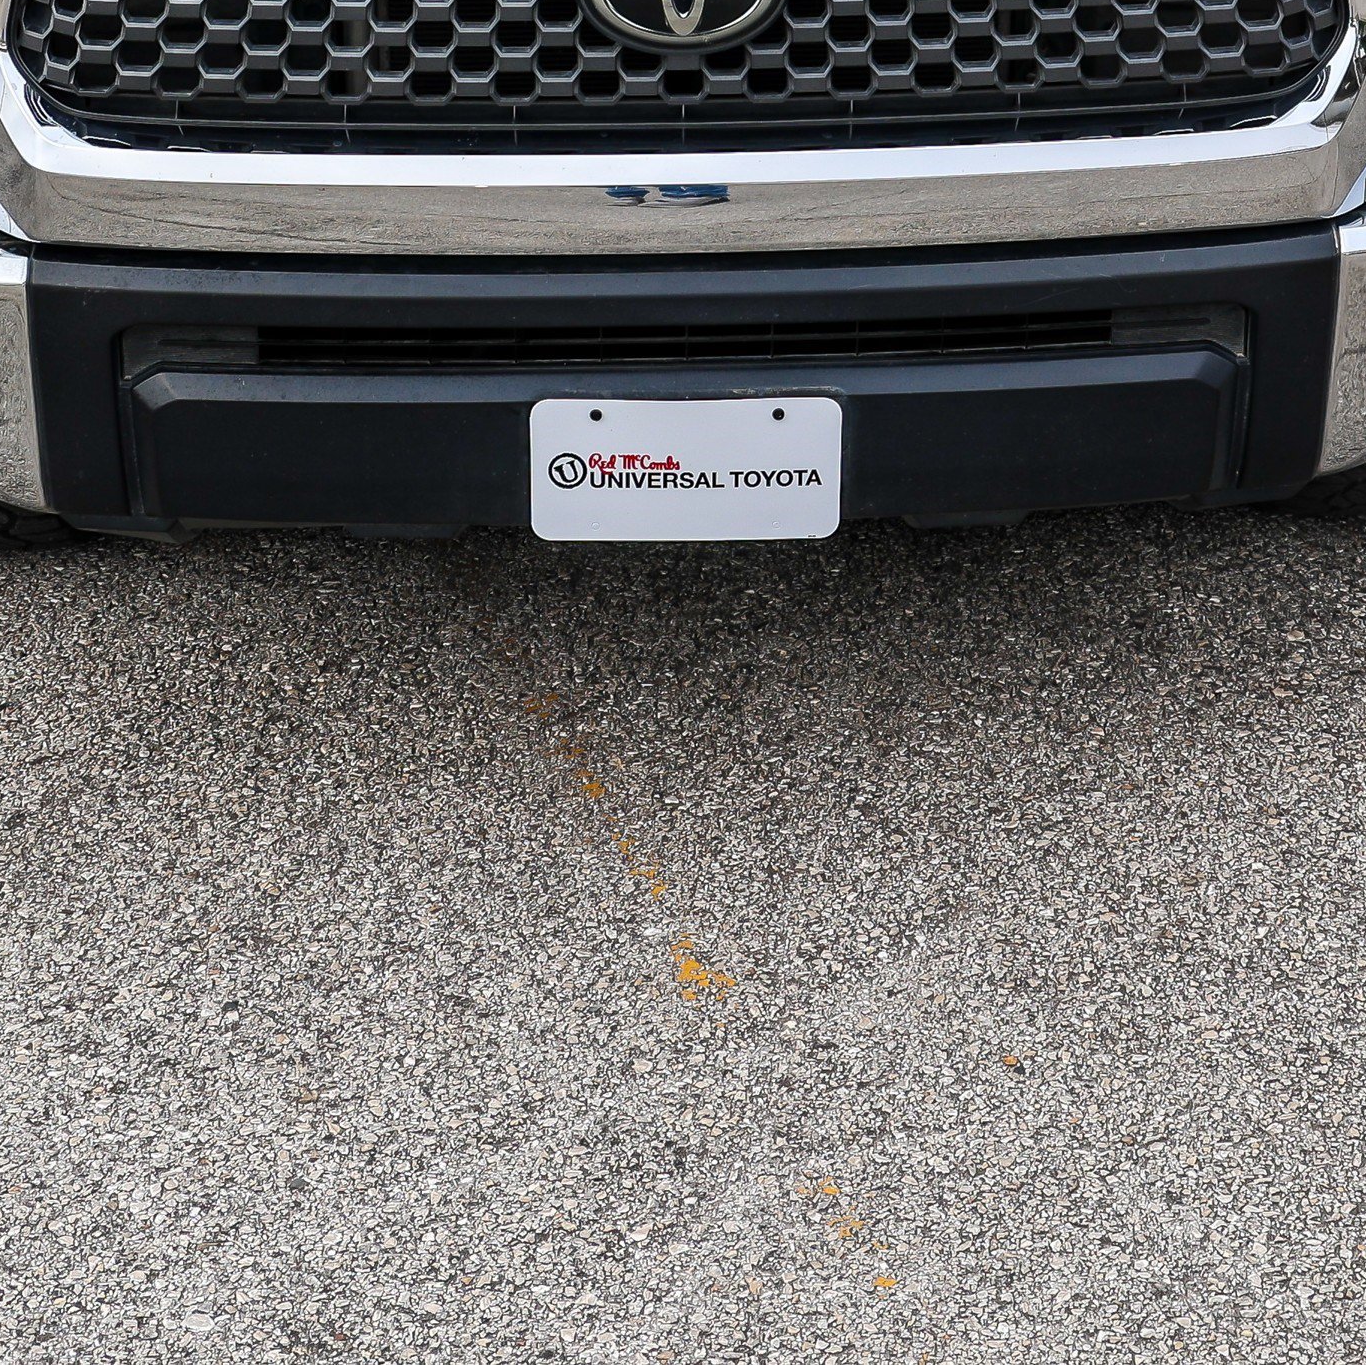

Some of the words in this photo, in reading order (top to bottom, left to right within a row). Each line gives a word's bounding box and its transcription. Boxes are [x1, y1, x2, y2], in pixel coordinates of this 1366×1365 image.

[588, 453, 617, 475] Red
[618, 454, 681, 471] McCombs
[589, 471, 725, 489] UNIVERSAL
[729, 469, 823, 488] TOYOTA
